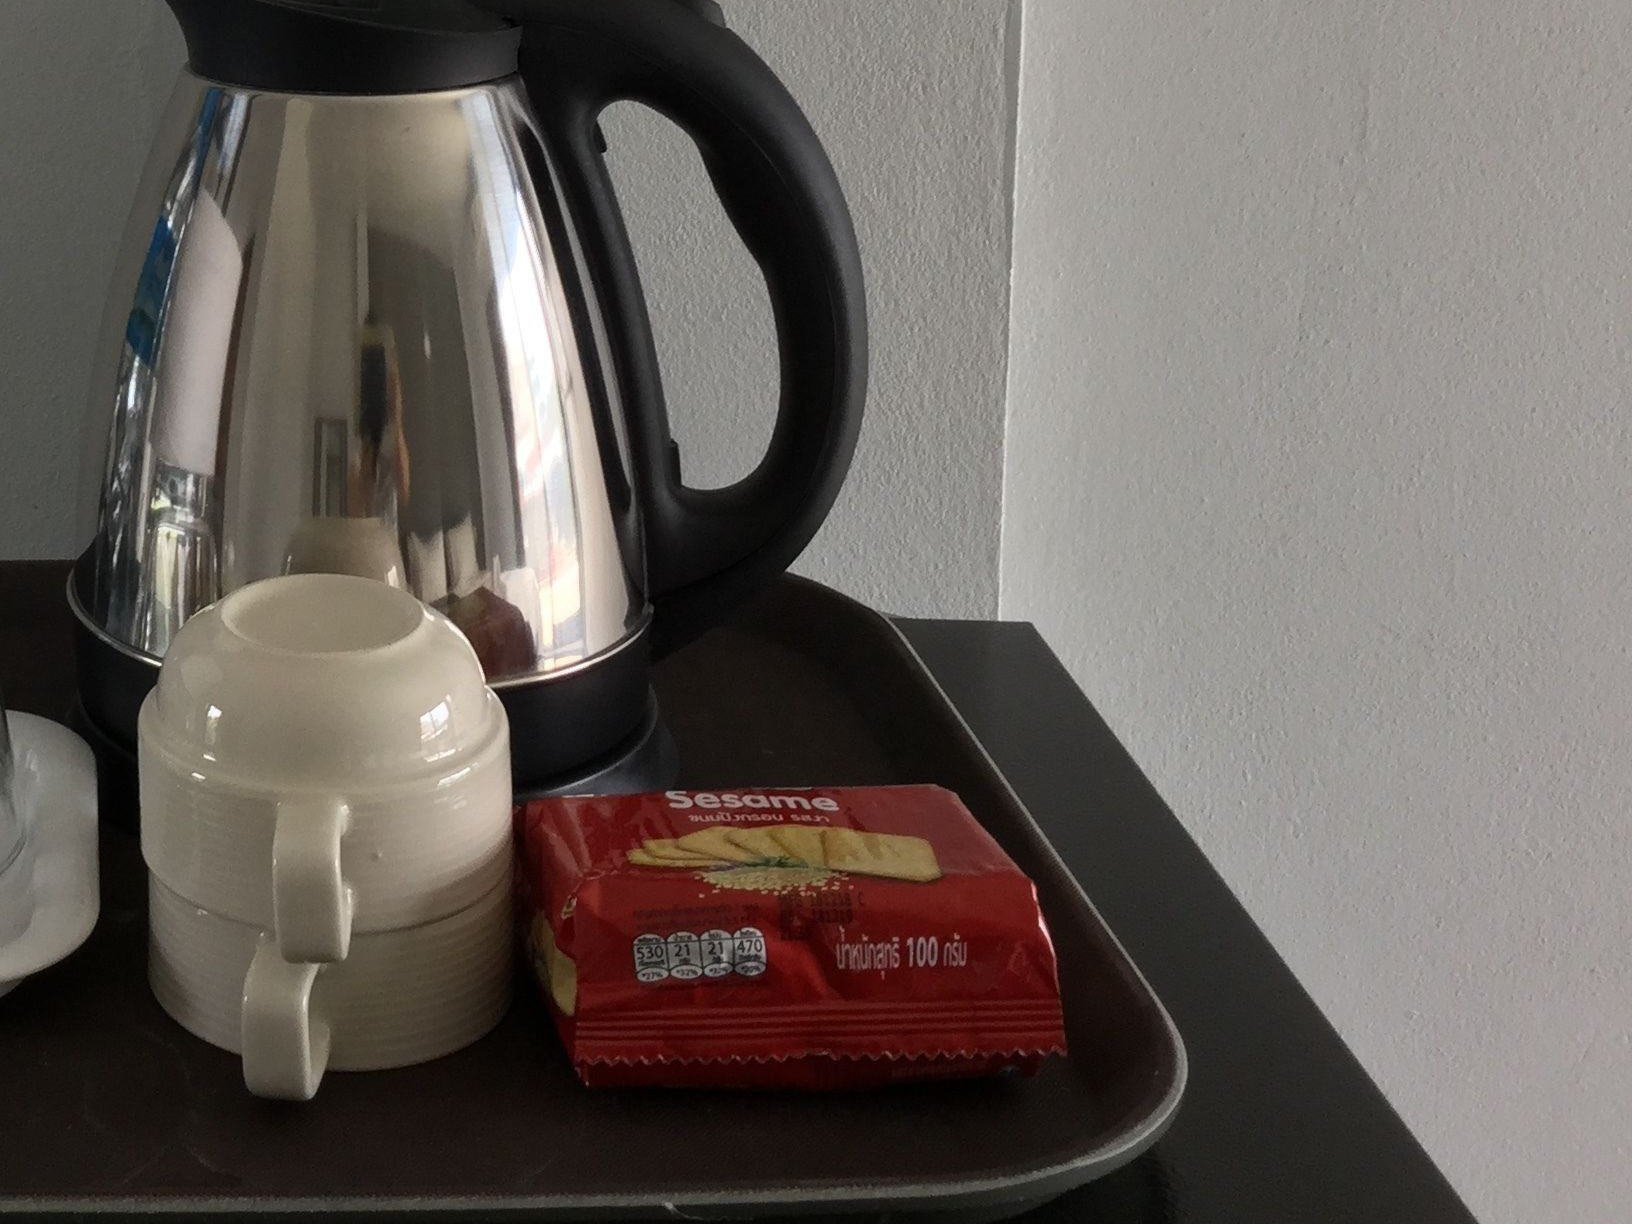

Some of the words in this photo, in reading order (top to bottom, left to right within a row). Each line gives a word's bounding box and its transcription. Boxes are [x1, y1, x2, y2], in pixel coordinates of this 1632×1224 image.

[664, 789, 840, 812] Sesame
[636, 945, 664, 960] 530
[674, 943, 691, 958] 21
[708, 941, 724, 955] 21
[737, 938, 763, 953] 470
[835, 925, 901, 980] น้ำหนักสุทธิ
[906, 936, 938, 968] 100
[943, 932, 969, 968] กรัม
